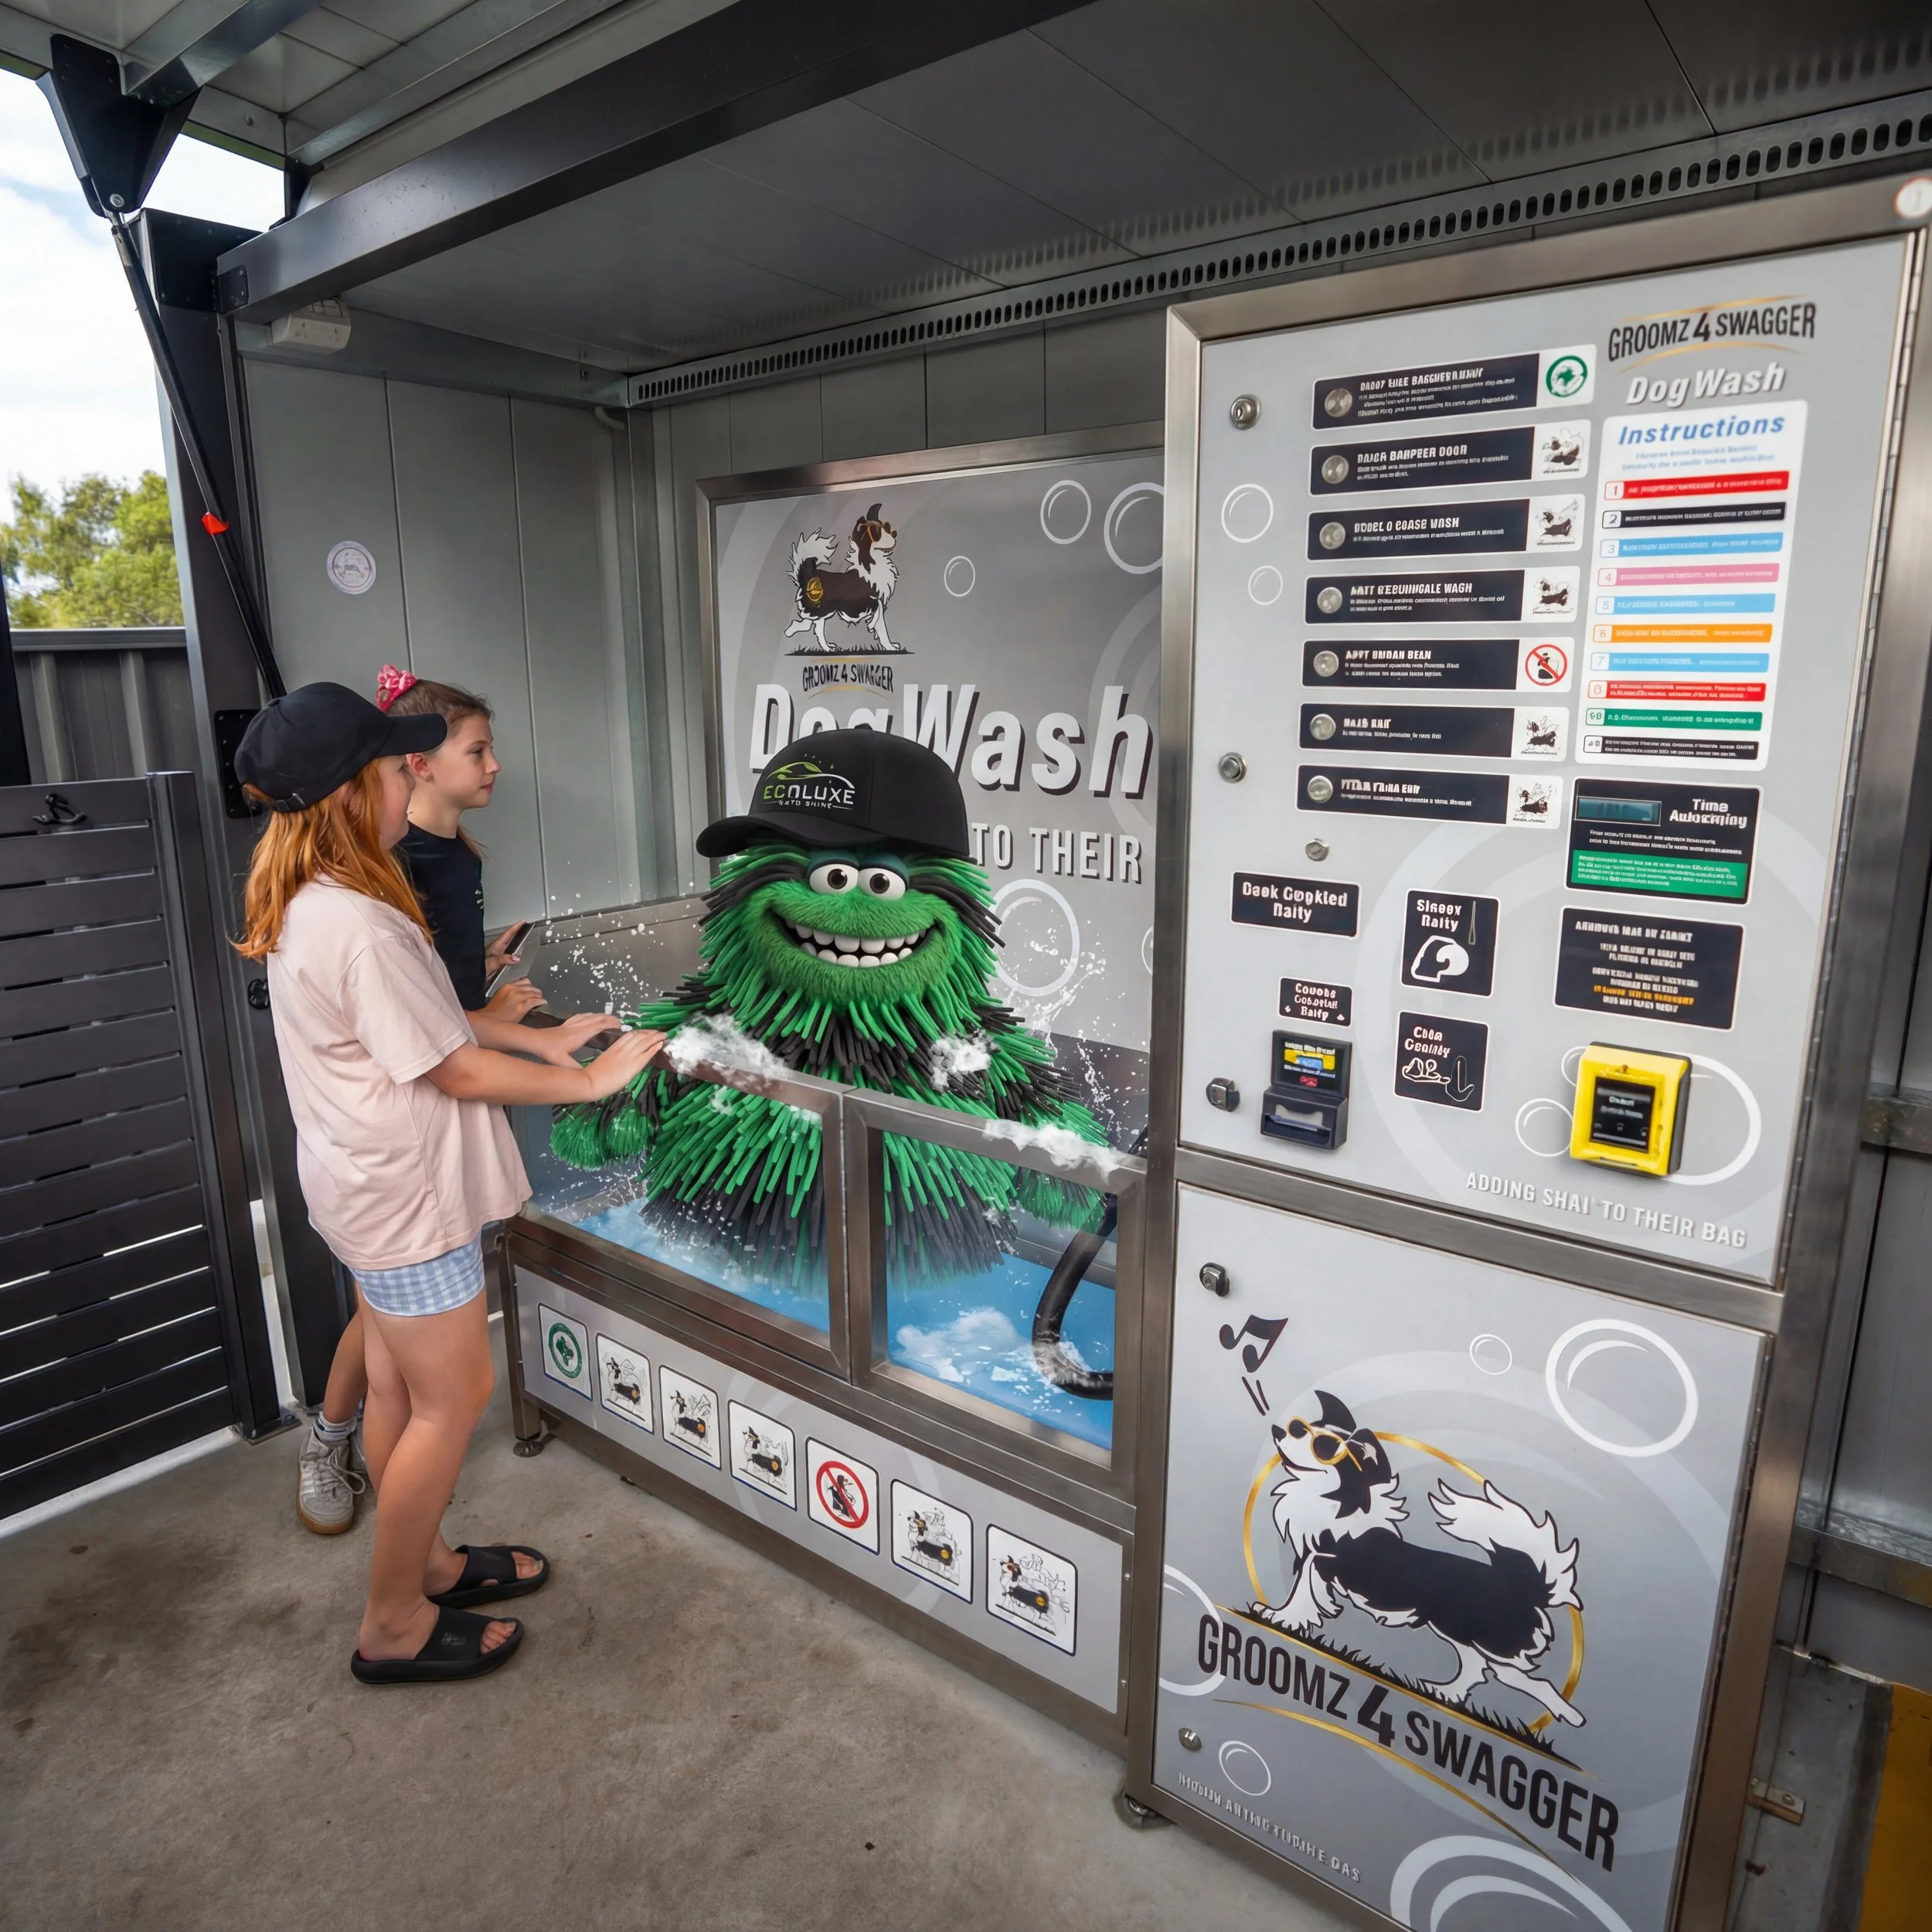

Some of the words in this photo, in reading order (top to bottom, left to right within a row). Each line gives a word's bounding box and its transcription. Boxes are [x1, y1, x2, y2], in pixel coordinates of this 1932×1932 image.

[1608, 318, 1690, 362] GROOMZ
[1692, 312, 1711, 342] 4
[1715, 302, 1817, 339] SWAGGER
[1626, 376, 1691, 409] Dog
[1694, 362, 1787, 399] Wash
[1618, 415, 1786, 446] Instructions
[1613, 485, 1619, 496] 1
[1609, 514, 1618, 525] 2
[1607, 543, 1615, 554] 3
[1604, 572, 1613, 582] 4
[1602, 601, 1610, 611] 5
[1600, 629, 1607, 638] 6
[1597, 656, 1605, 667] 7
[903, 683, 1151, 798] Wash
[971, 822, 1012, 869] TO
[1029, 827, 1142, 883] THEIR
[1465, 1171, 1536, 1202] ADDING
[1600, 1200, 1626, 1223] TO
[1633, 1206, 1695, 1238] THEIR
[1701, 1222, 1747, 1250] BAG
[1197, 1614, 1350, 1721] GROOMZ
[1358, 1685, 1396, 1748] 4
[1405, 1710, 1620, 1873] SWAGGER
